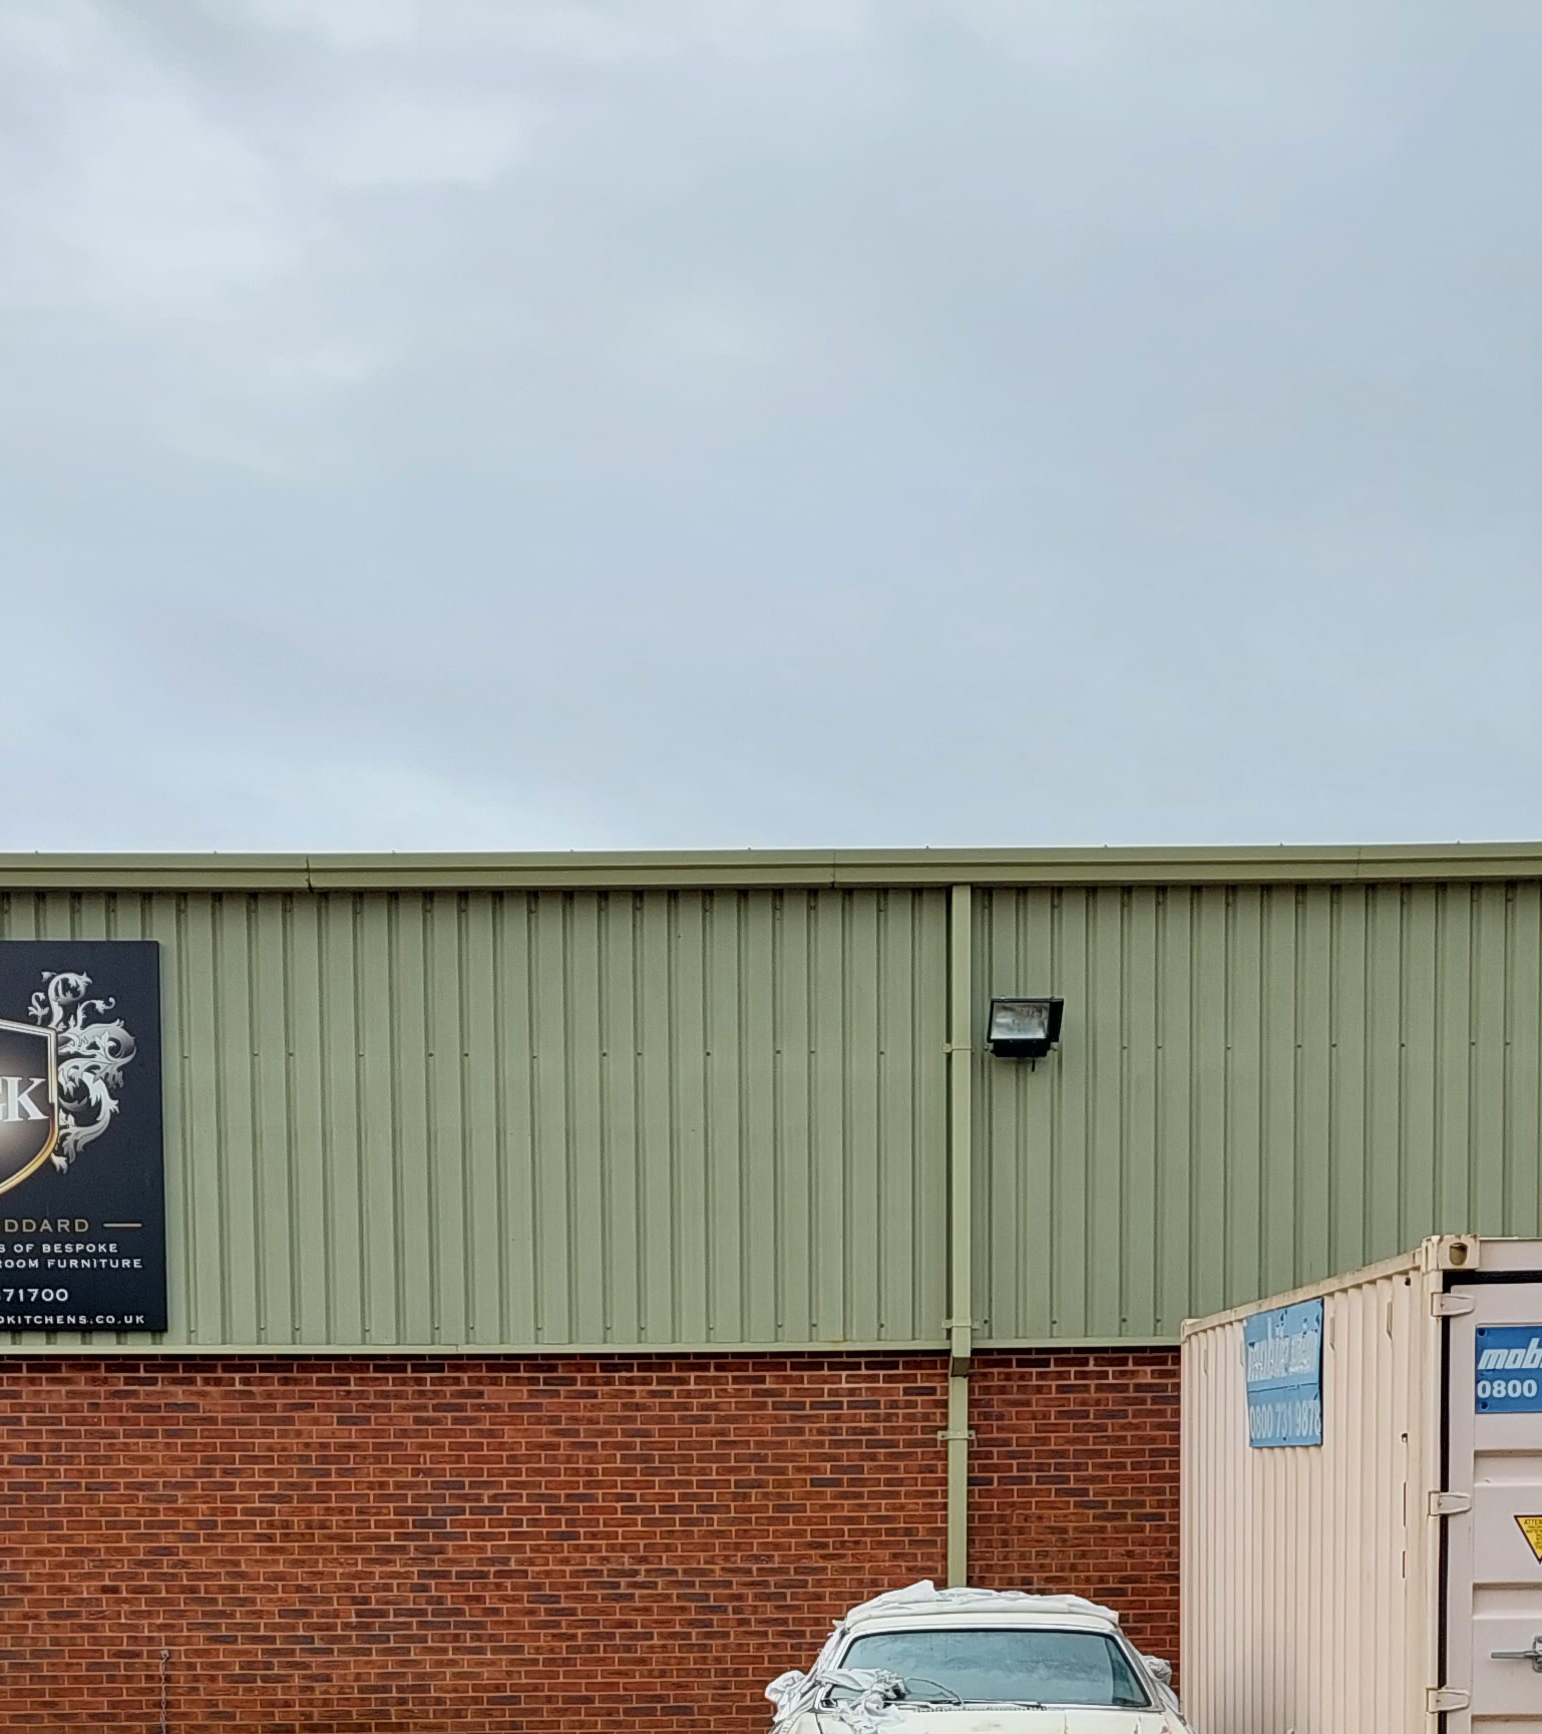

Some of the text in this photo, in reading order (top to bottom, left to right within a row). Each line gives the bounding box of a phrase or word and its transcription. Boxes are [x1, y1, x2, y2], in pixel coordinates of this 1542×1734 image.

[13, 1244, 34, 1253] OF
[43, 1244, 118, 1253] BESPOKE
[47, 1258, 143, 1268] FURNITURE
[1477, 1380, 1537, 1398] 0800
